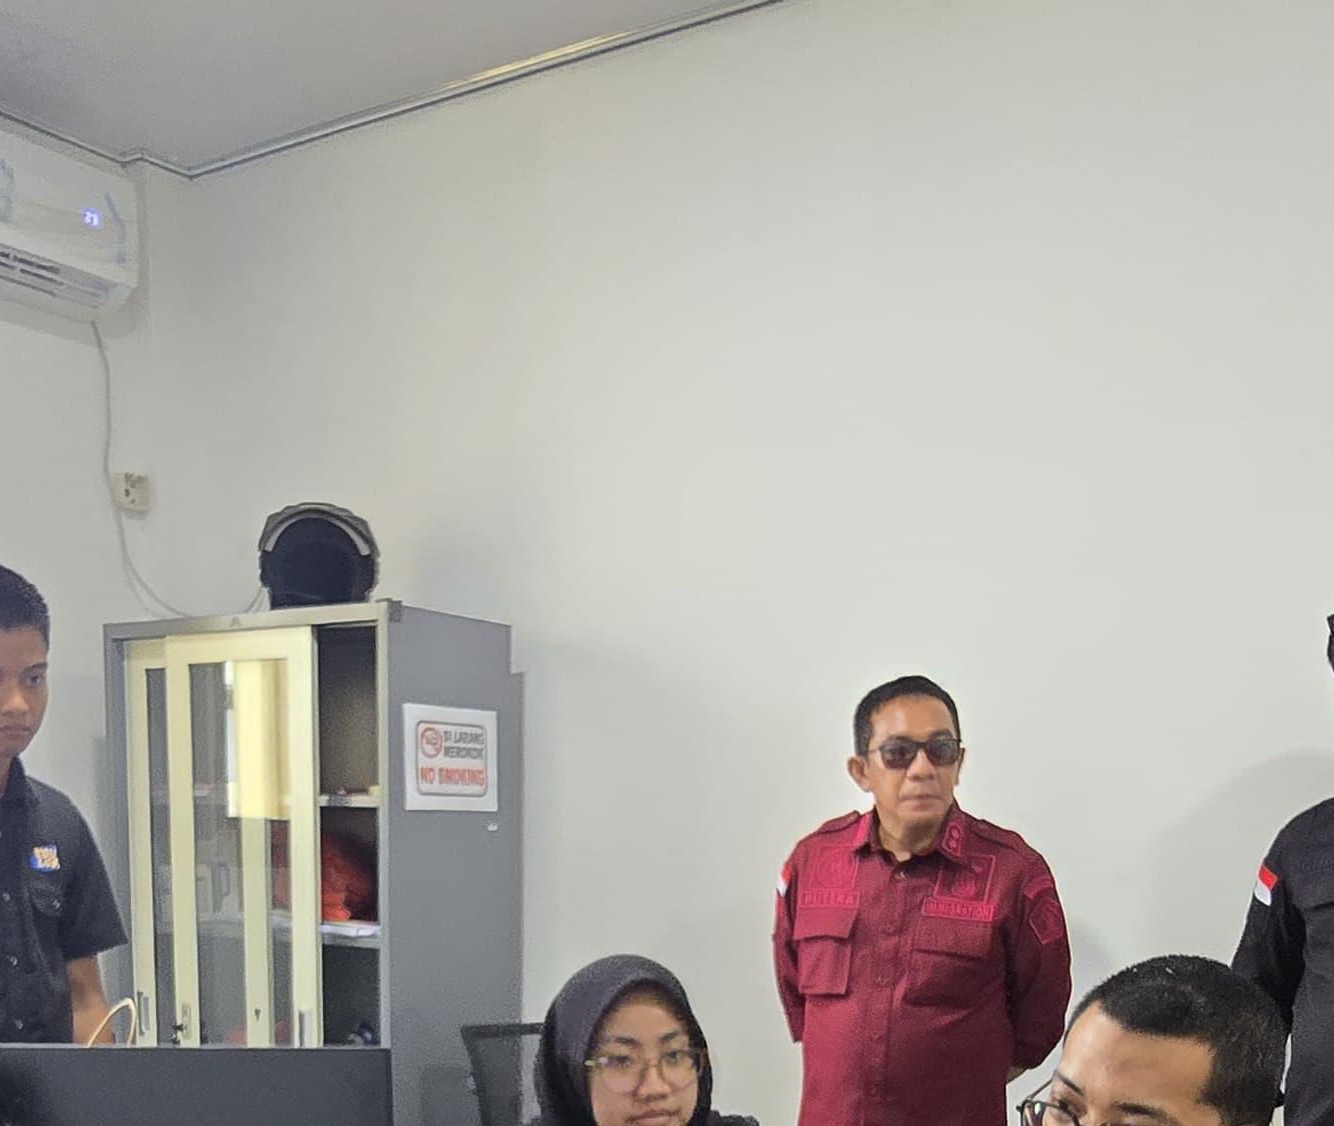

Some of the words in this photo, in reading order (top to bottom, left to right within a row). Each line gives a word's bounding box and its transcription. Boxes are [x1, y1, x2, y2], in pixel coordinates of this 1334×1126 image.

[454, 730, 484, 745] LARANG
[420, 767, 436, 784] NO
[438, 767, 485, 787] SMOKING
